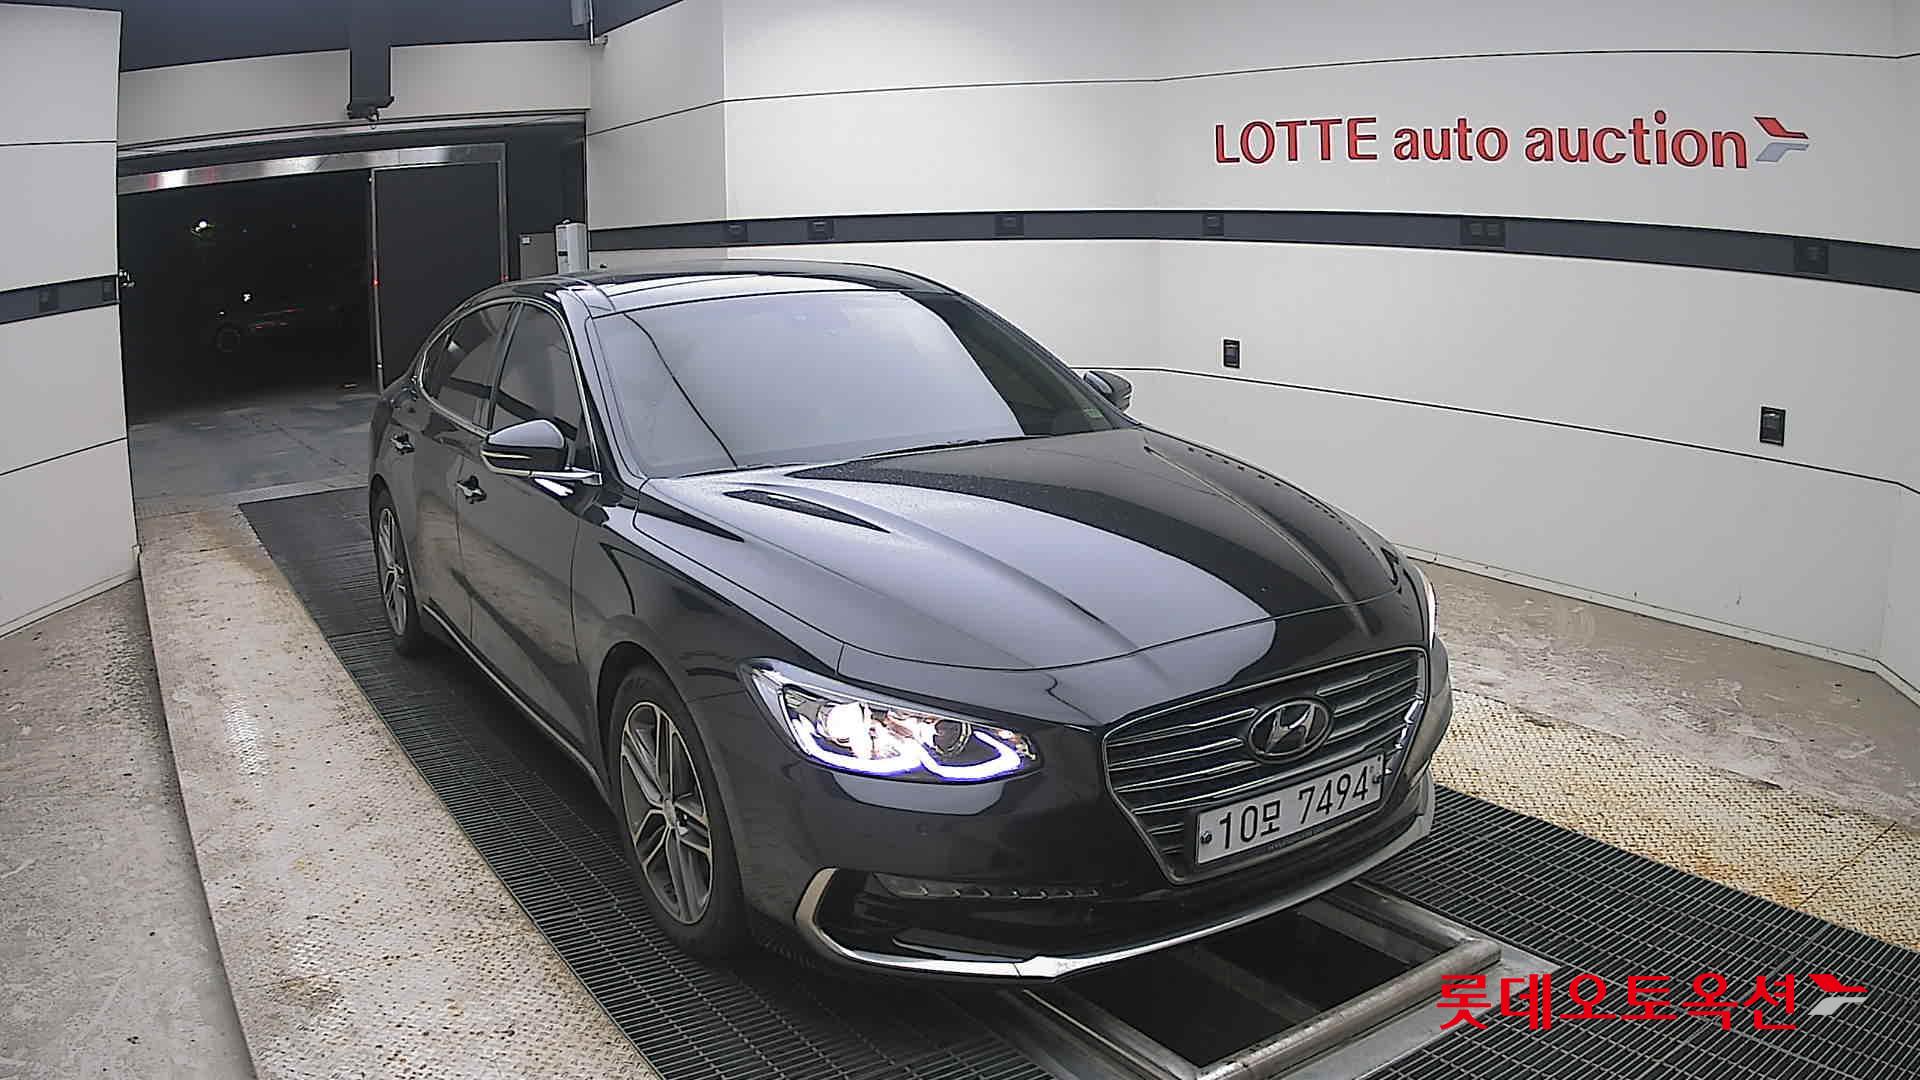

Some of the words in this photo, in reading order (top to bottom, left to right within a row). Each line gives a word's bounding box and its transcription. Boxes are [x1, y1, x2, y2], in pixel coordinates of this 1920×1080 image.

[1215, 117, 1377, 164] LOTTE
[1393, 118, 1508, 162] auto
[1524, 110, 1748, 168] auction
[1219, 800, 1281, 849] 10모
[1299, 766, 1369, 825] 7494
